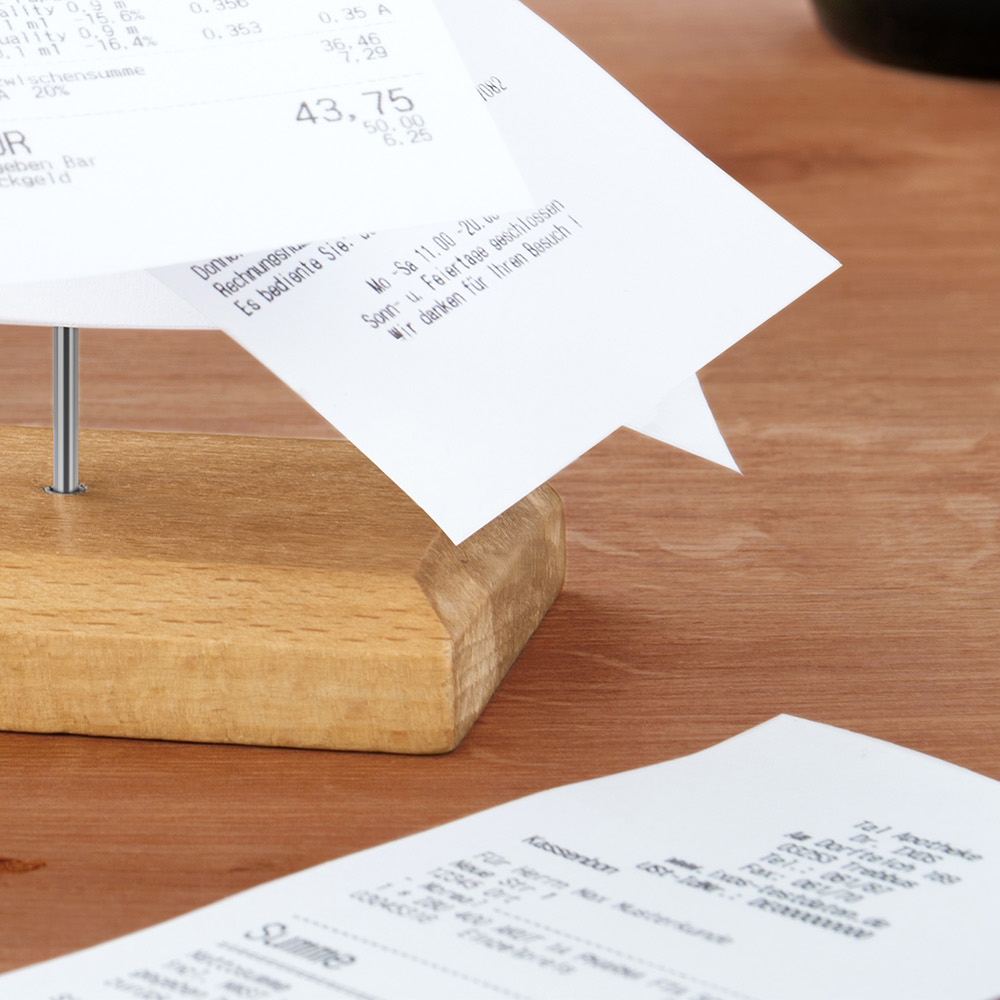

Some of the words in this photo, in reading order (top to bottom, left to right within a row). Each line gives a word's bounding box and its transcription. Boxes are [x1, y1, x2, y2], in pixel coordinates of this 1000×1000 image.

[377, 2, 392, 16] A
[31, 84, 70, 98] 20%
[295, 87, 415, 125] 43,75
[62, 154, 96, 168] Bar
[419, 243, 490, 293] Feiertage
[489, 198, 566, 252] geschlossen
[233, 298, 261, 317] Es
[255, 261, 324, 303] bediente
[365, 272, 392, 295] Mo
[388, 321, 418, 344] Wir
[419, 294, 462, 326] danken
[461, 276, 490, 299] für
[487, 254, 531, 281] Ihren
[521, 225, 573, 259] Besuch
[522, 834, 619, 875] Kassenbon
[891, 832, 984, 862] Apotheke
[243, 921, 357, 970] Summe
